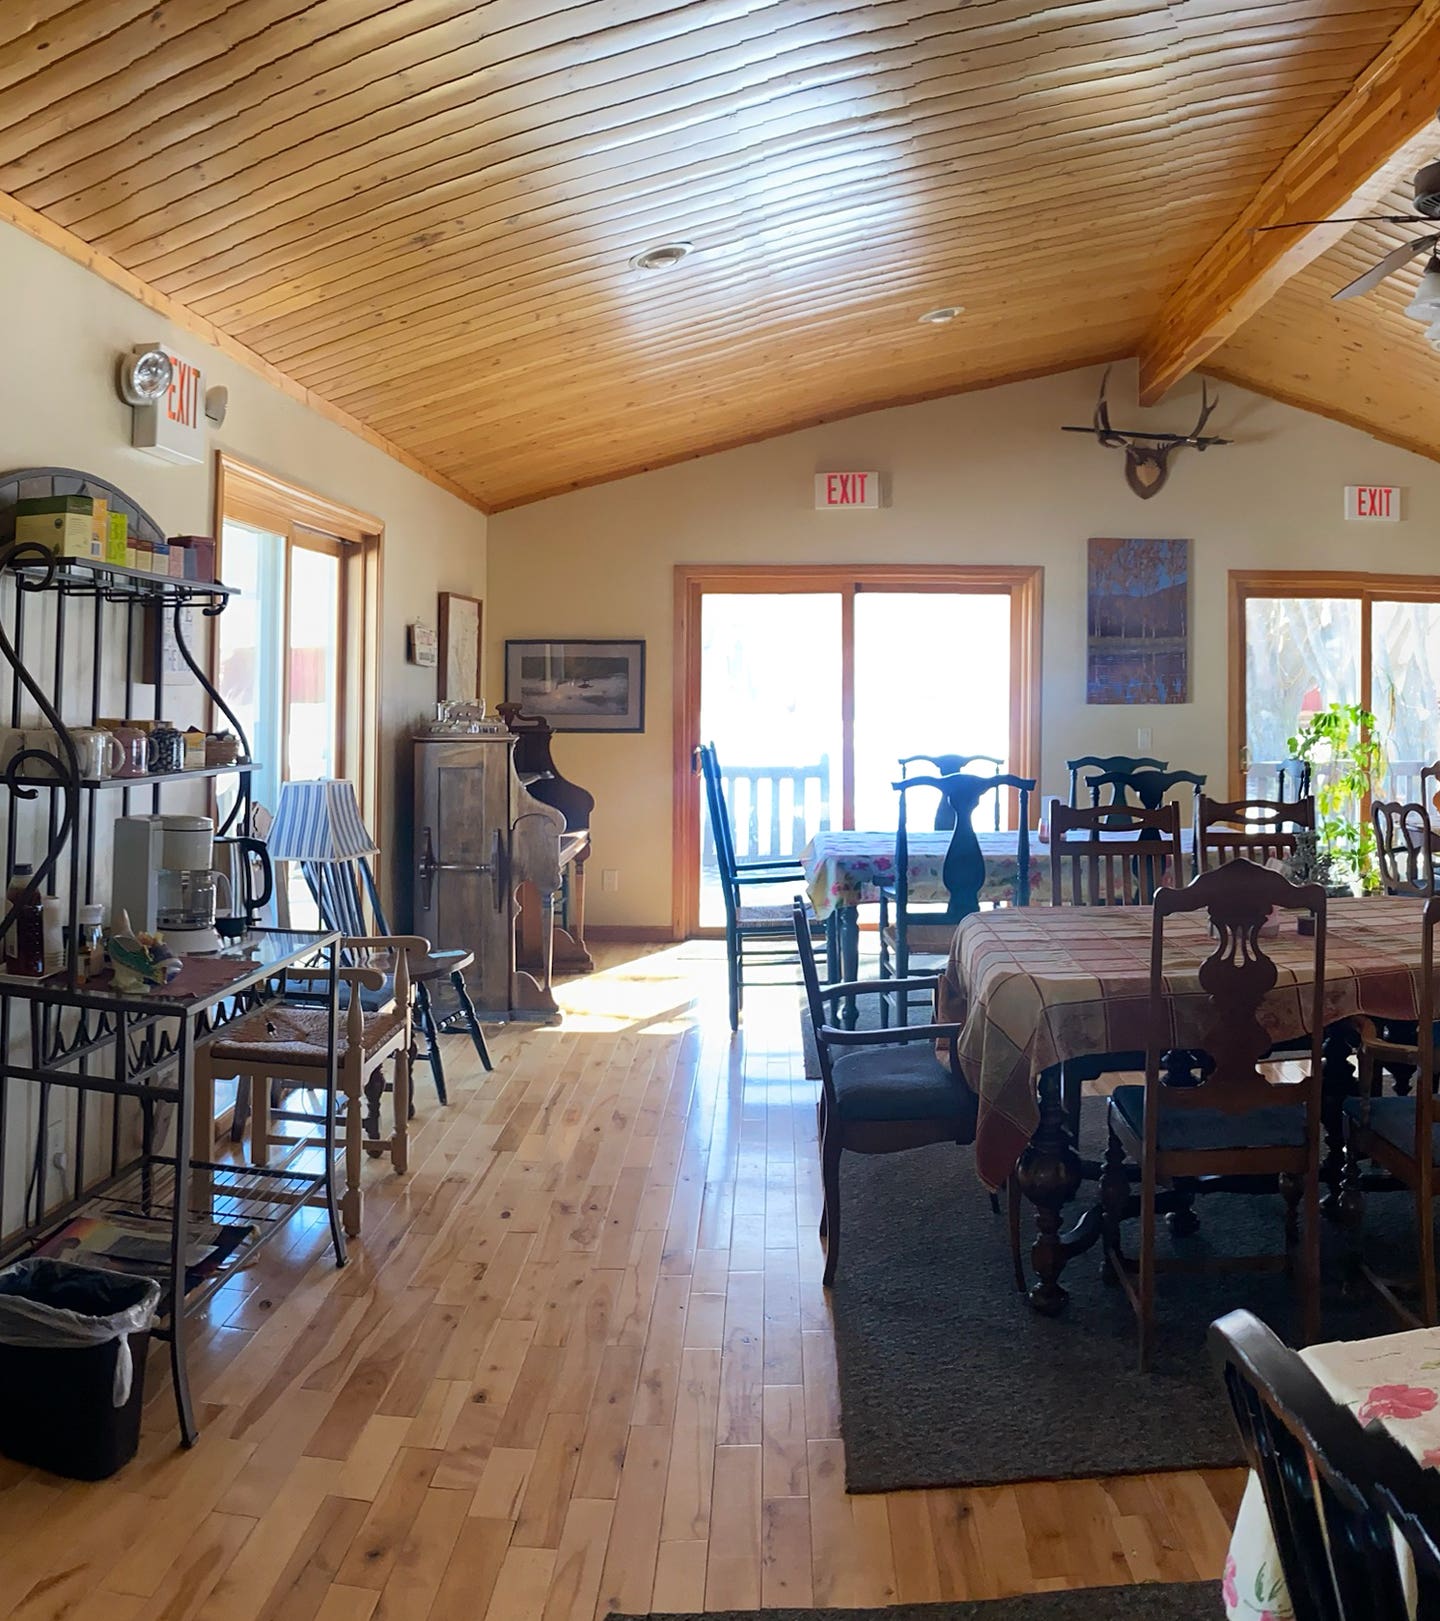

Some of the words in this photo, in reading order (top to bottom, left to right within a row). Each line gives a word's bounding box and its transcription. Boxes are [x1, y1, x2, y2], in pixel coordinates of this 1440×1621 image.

[167, 356, 200, 429] EXIT
[827, 474, 868, 504] EXIT
[1358, 488, 1392, 516] EXIT
